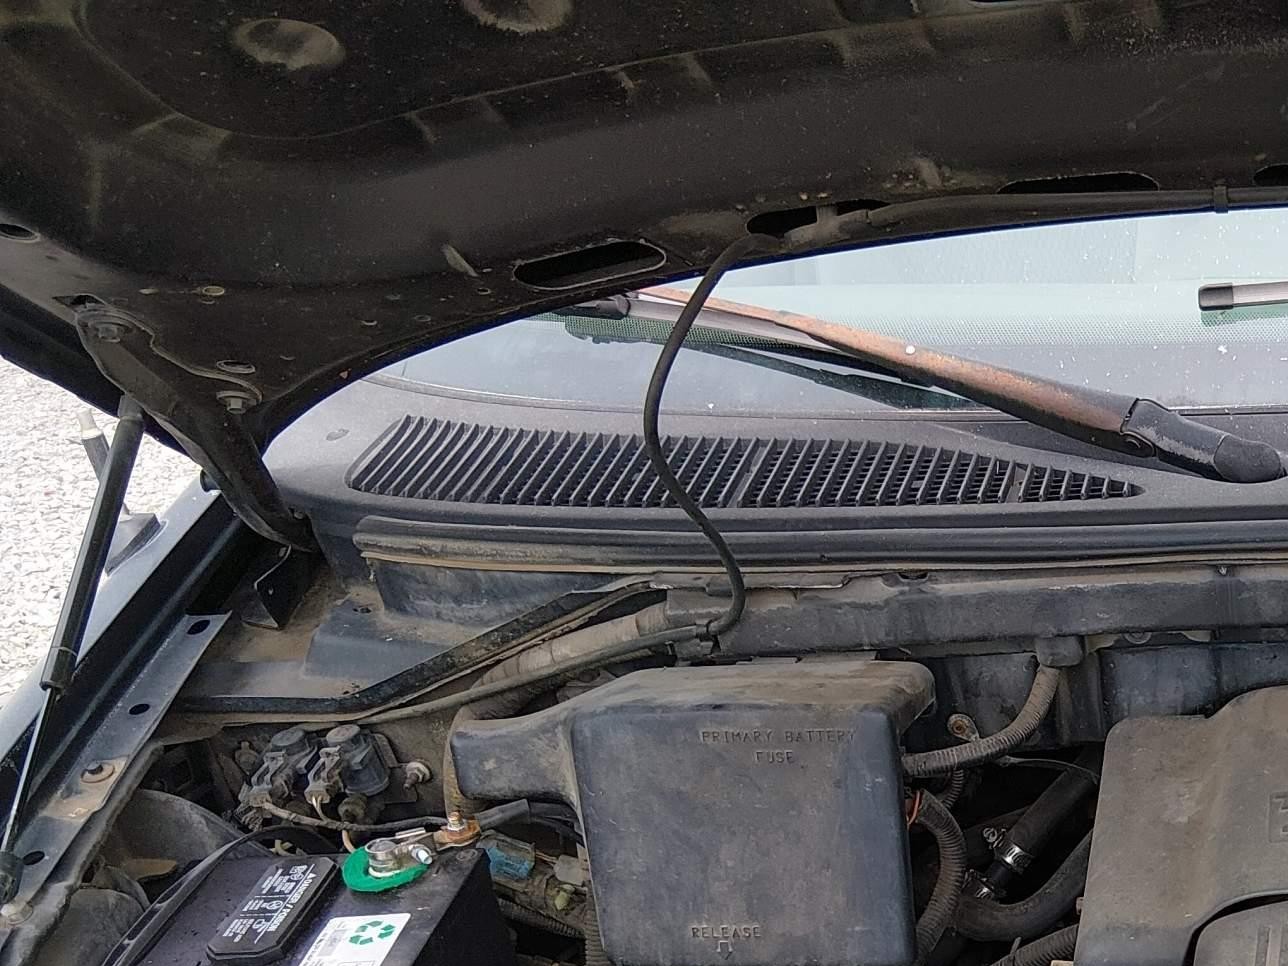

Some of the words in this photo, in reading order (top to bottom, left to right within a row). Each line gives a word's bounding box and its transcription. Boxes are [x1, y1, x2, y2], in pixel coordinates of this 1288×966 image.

[701, 729, 773, 743] PRIMARY
[785, 729, 856, 743] BATTERY
[755, 749, 795, 765] FUSE
[691, 925, 762, 939] RELEASE
